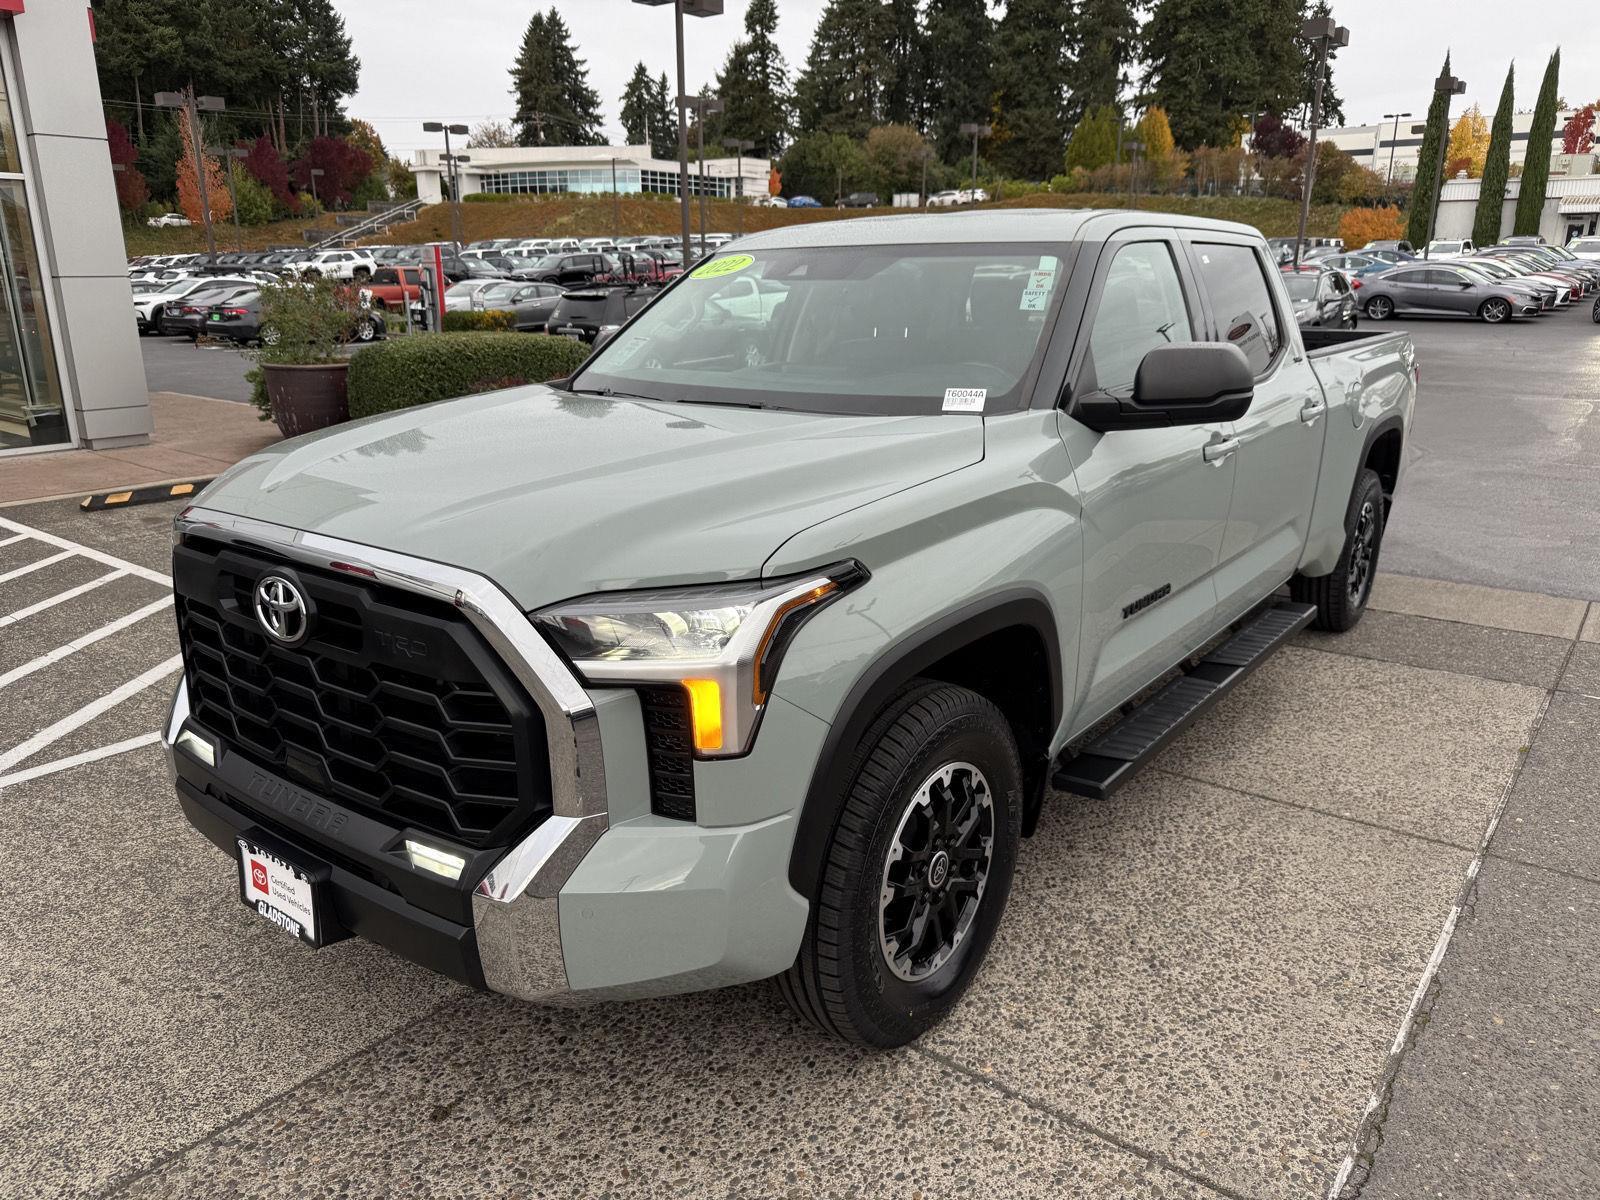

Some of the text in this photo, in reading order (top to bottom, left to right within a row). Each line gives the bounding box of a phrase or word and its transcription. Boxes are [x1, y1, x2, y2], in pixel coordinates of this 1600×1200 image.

[947, 389, 984, 398] T60044A
[374, 627, 428, 658] TRD
[247, 770, 349, 831] TUNDRA
[270, 874, 296, 896] Certified
[272, 886, 311, 916] Used Vehicles
[258, 901, 301, 939] GLADSTONE
